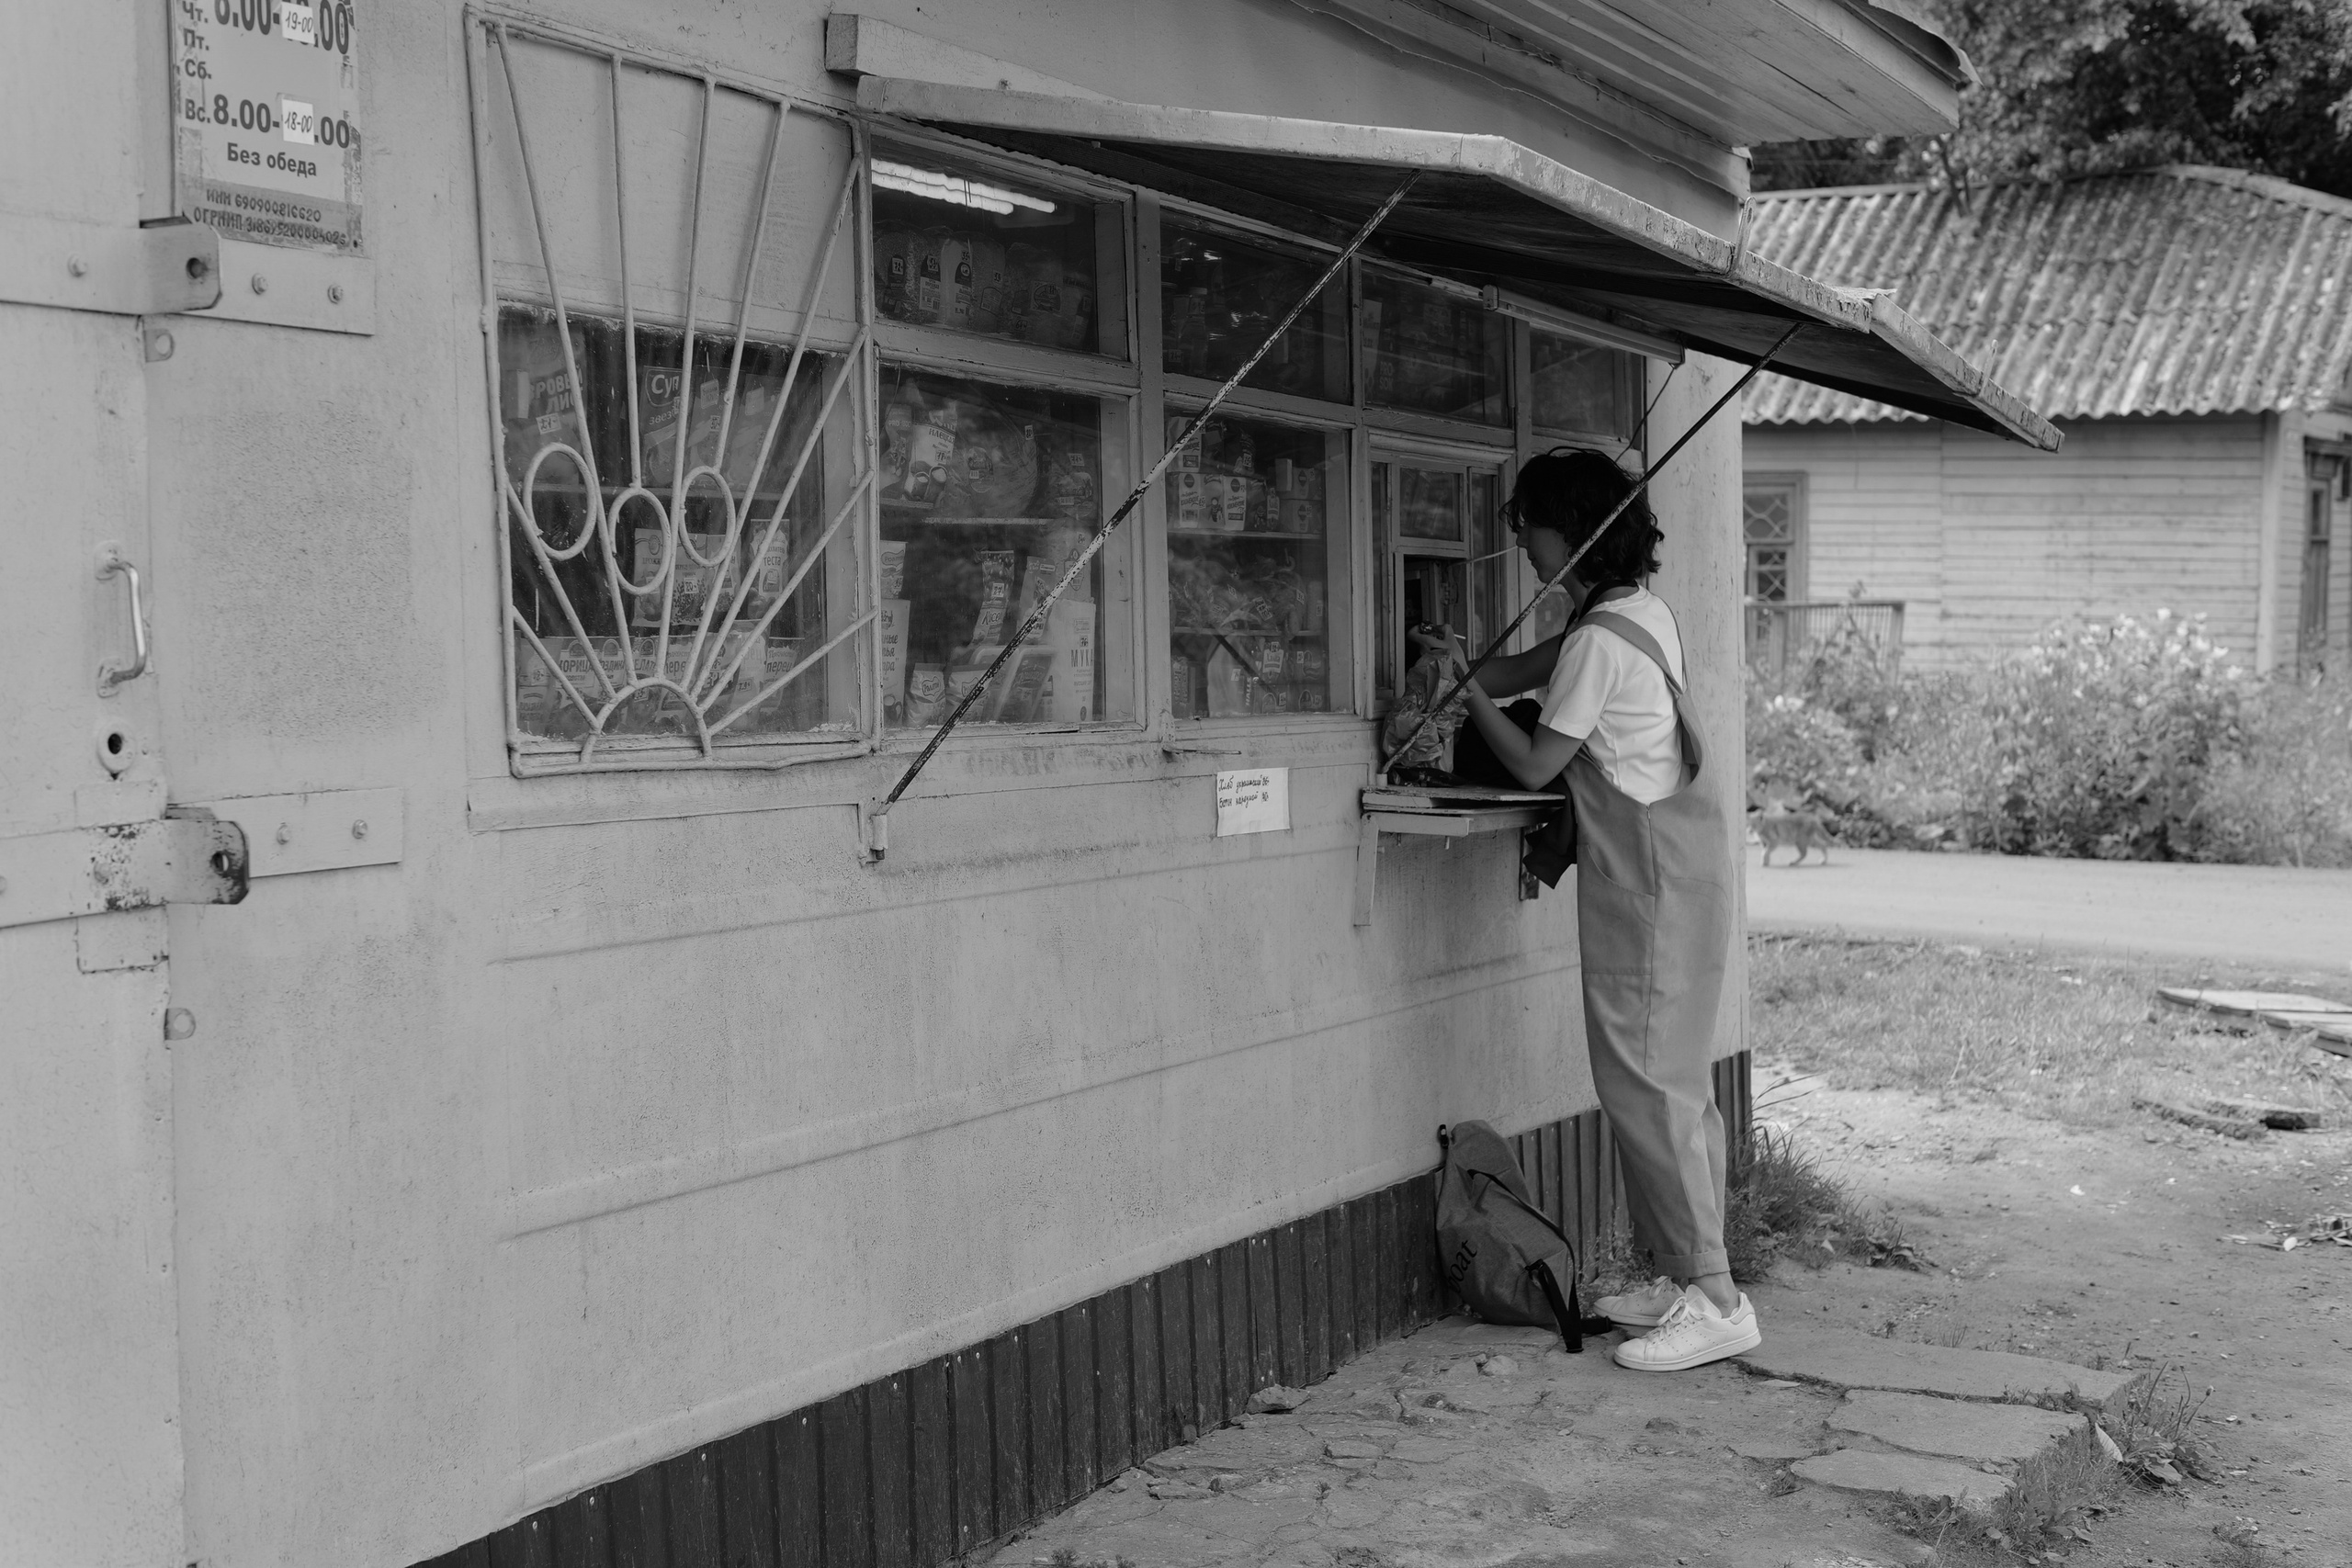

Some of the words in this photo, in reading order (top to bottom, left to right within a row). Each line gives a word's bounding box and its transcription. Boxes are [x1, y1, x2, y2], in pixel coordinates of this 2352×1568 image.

[285, 11, 313, 33] 19-00
[184, 28, 209, 51] Пт.
[185, 59, 212, 80] Сб.
[185, 98, 210, 124] Вс.
[284, 111, 313, 133] 18-00
[227, 141, 261, 166] Без
[266, 152, 317, 178] обеда
[207, 188, 232, 207] ИНН
[650, 374, 680, 399] Суп
